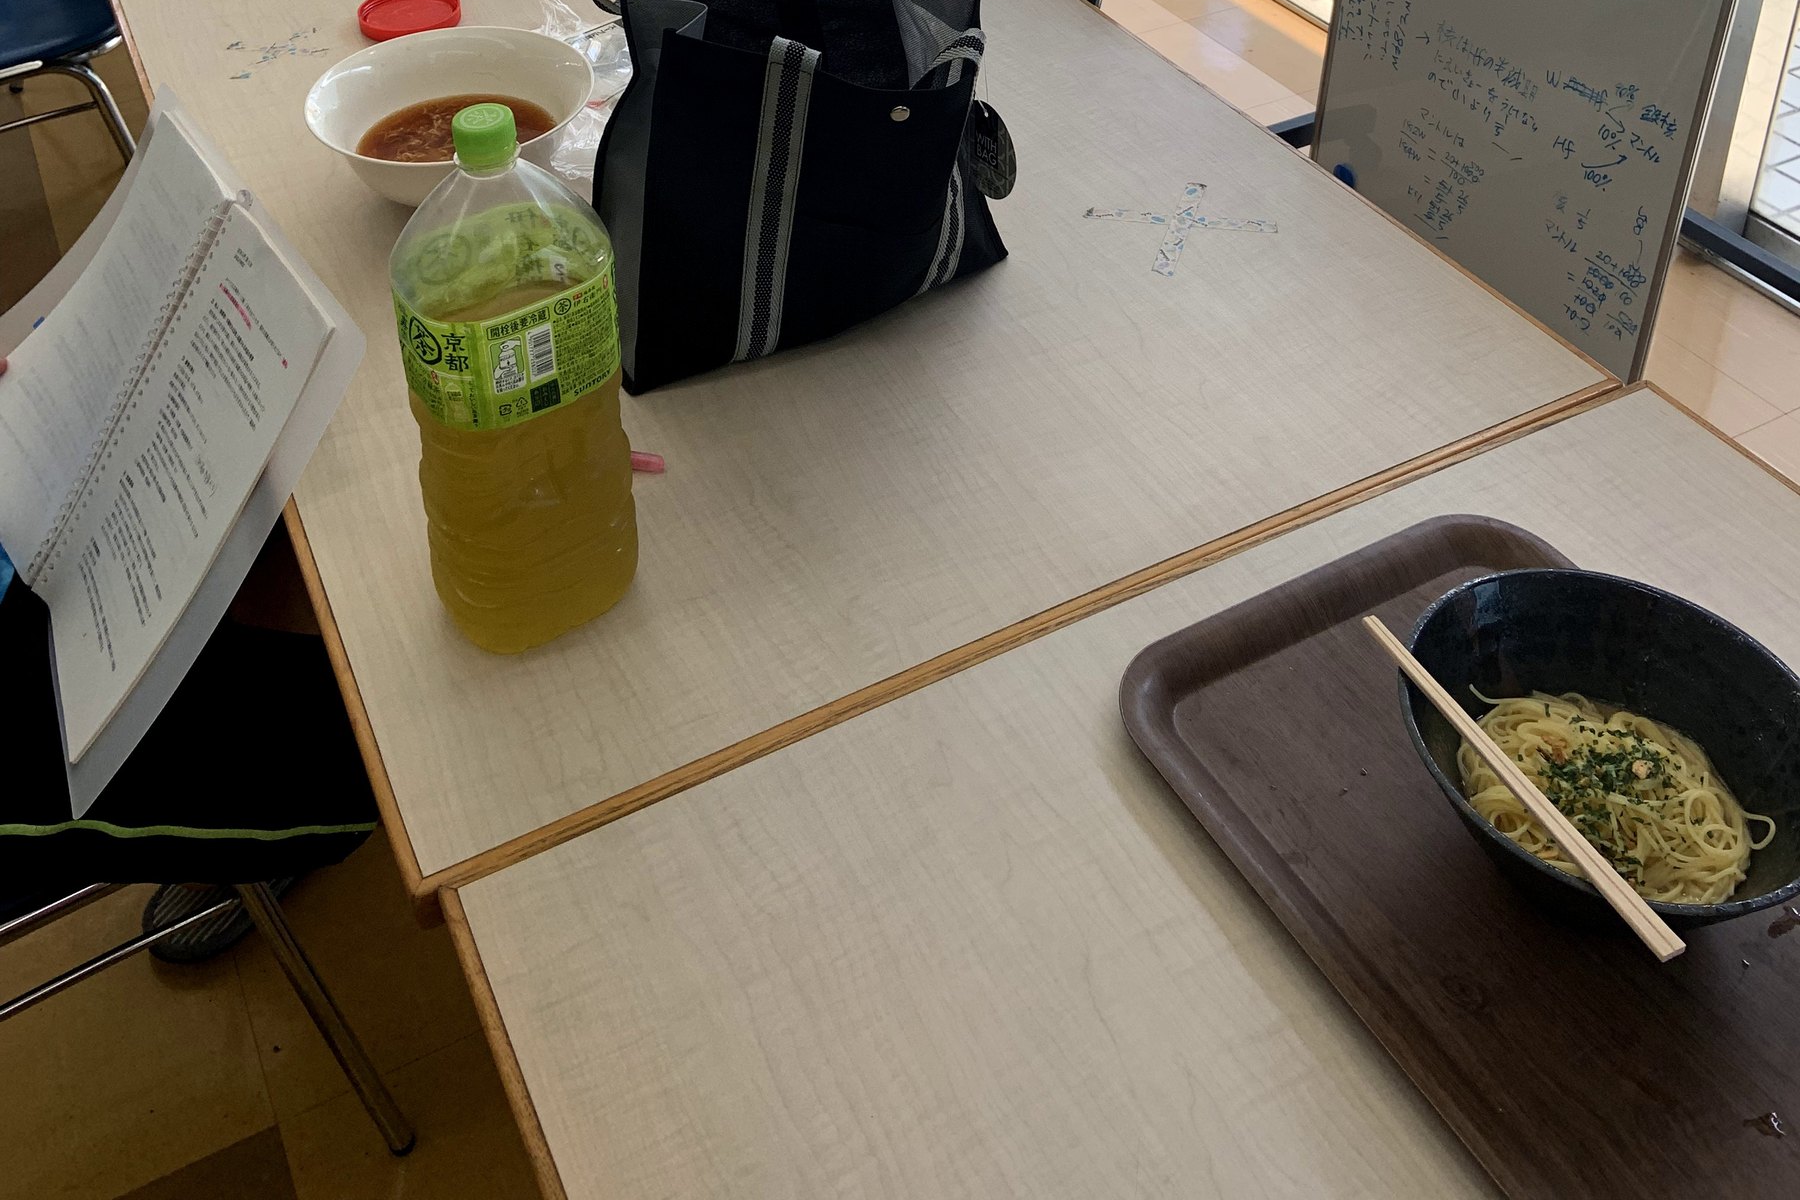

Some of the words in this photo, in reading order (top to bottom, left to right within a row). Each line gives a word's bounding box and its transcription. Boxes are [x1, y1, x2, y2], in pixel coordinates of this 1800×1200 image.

[976, 131, 997, 154] WITH
[976, 144, 997, 166] BAG
[556, 299, 570, 314] 茶
[489, 309, 548, 338] 開栓後要冷蔵
[411, 319, 438, 361] 茶
[441, 331, 470, 373] 京都
[573, 369, 612, 397] SUNTORY
